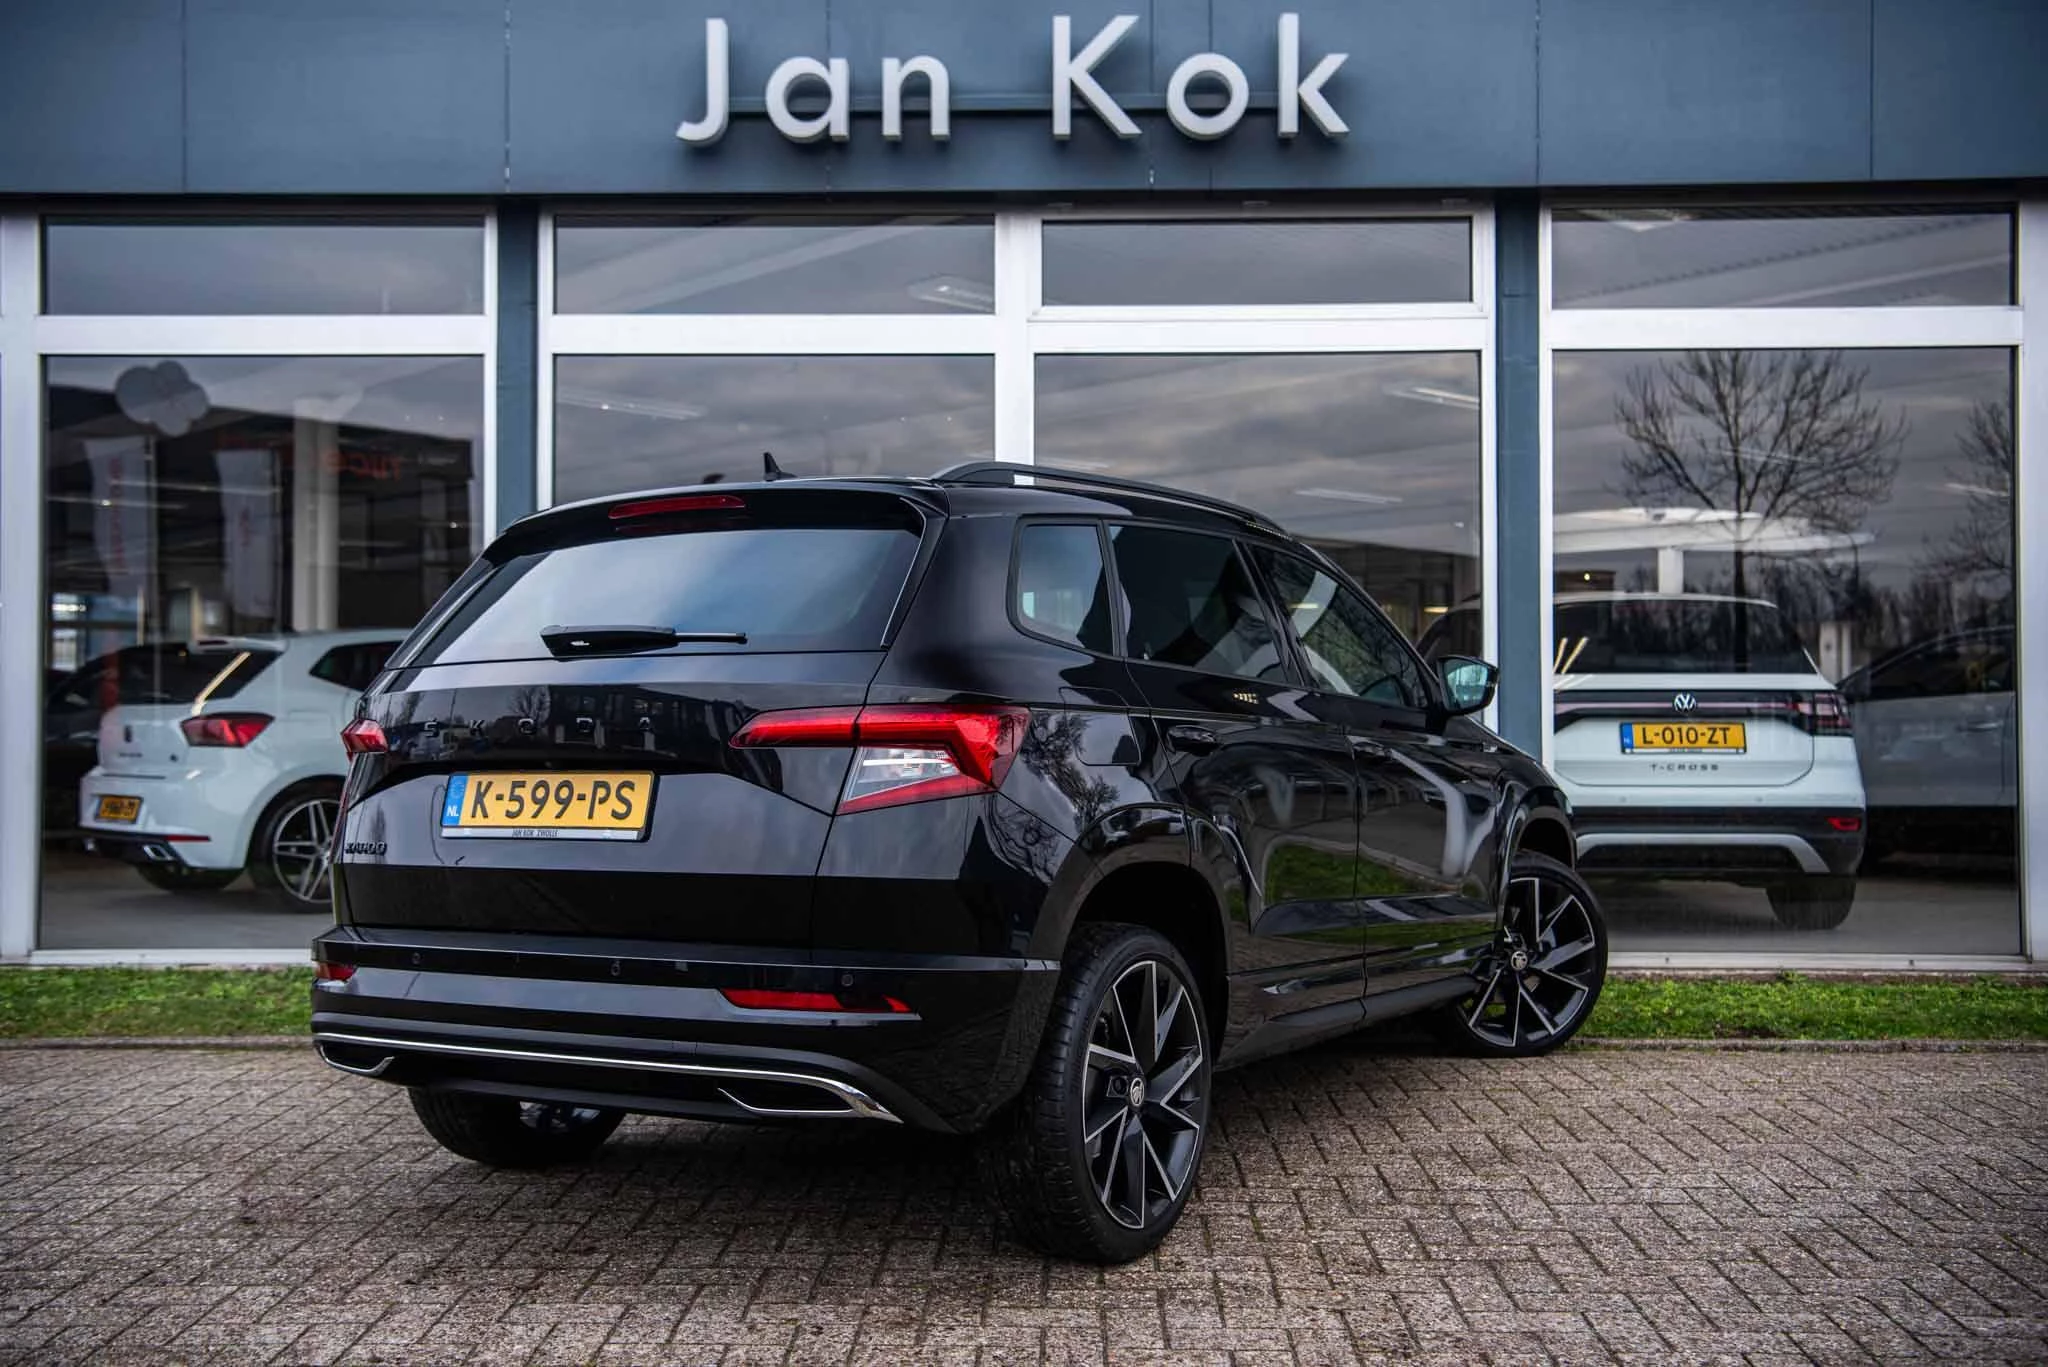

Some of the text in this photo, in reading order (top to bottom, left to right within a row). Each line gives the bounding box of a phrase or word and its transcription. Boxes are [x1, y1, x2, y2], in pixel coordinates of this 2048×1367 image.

[676, 13, 1350, 145] Jan Kok
[1642, 727, 1731, 745] L-010-ZT
[446, 805, 459, 817] NL
[471, 779, 636, 820] K-599-PS
